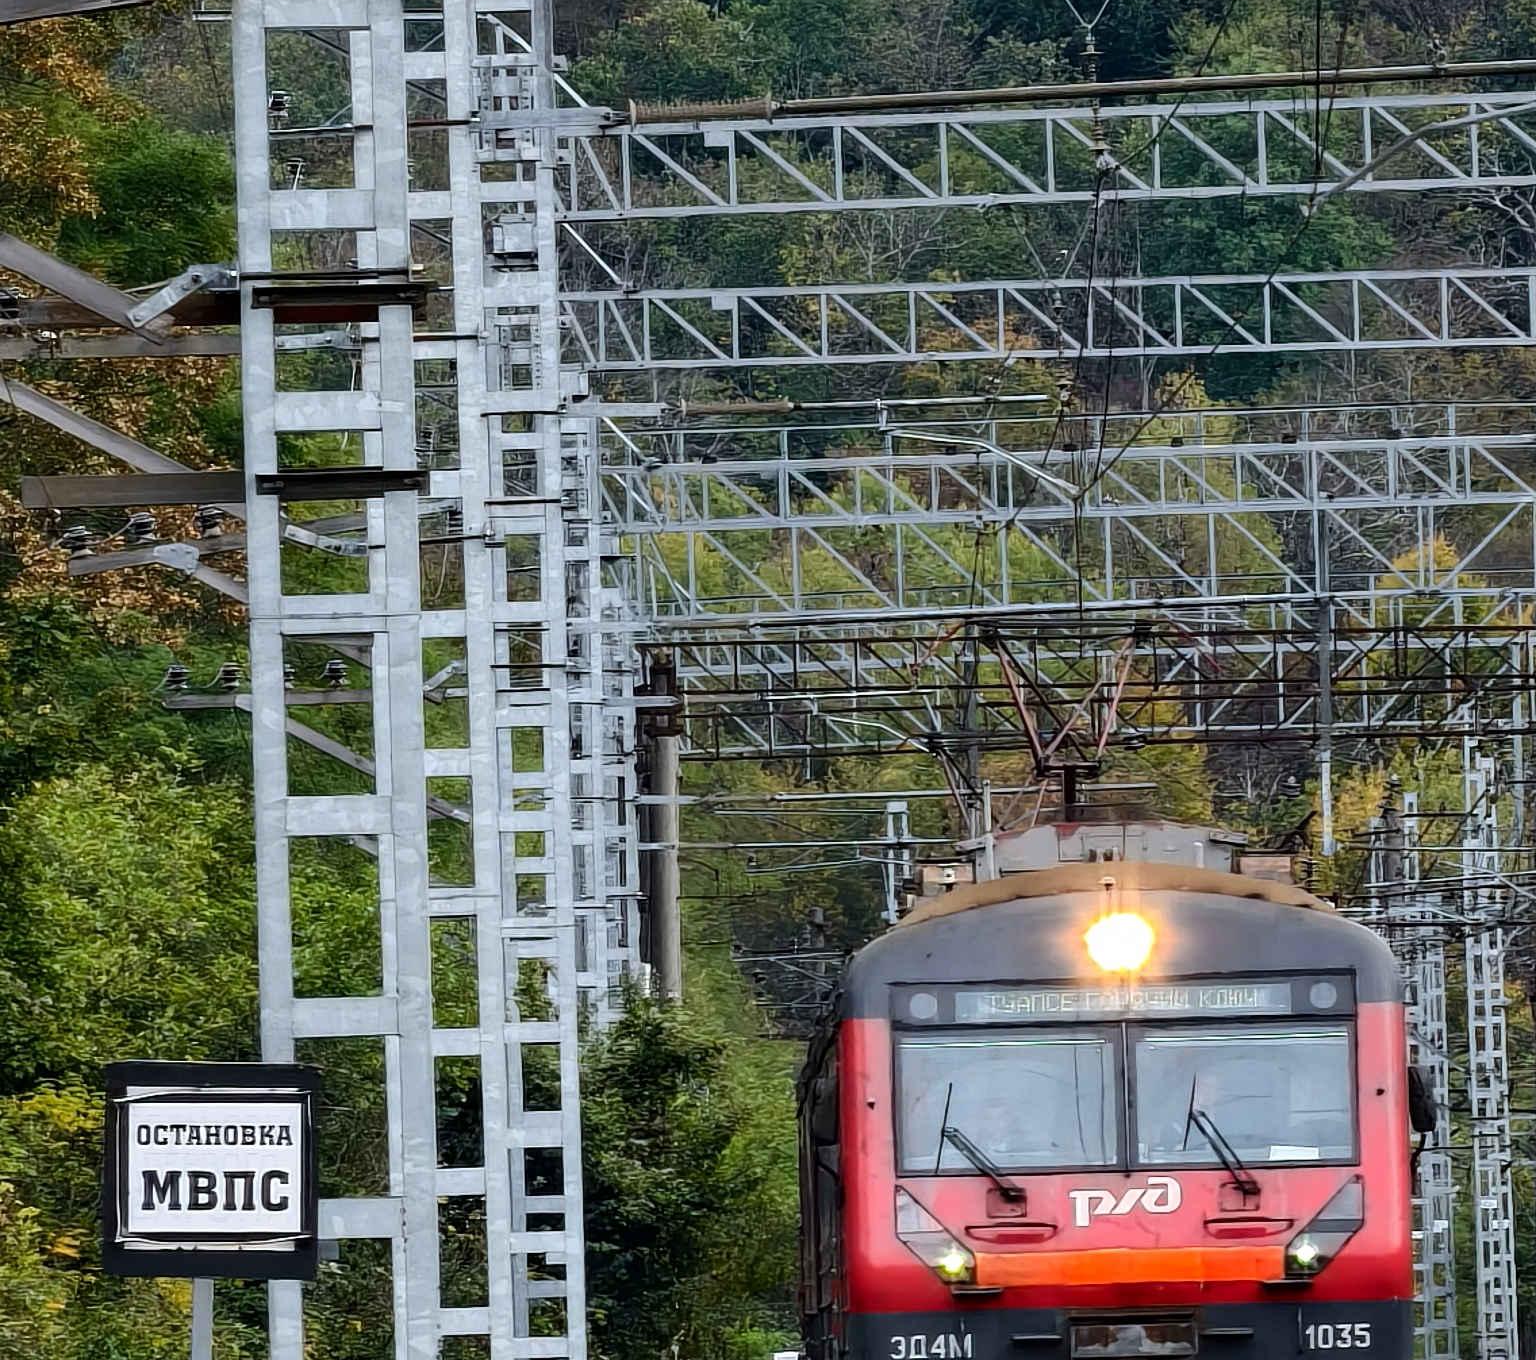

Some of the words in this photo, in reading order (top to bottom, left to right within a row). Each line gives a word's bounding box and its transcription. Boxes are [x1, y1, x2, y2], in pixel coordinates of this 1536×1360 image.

[136, 1124, 294, 1147] ОСТАНОВКА
[141, 1169, 290, 1212] МВПС
[889, 1333, 973, 1360] ЭД4М
[1305, 1322, 1372, 1350] 1035
